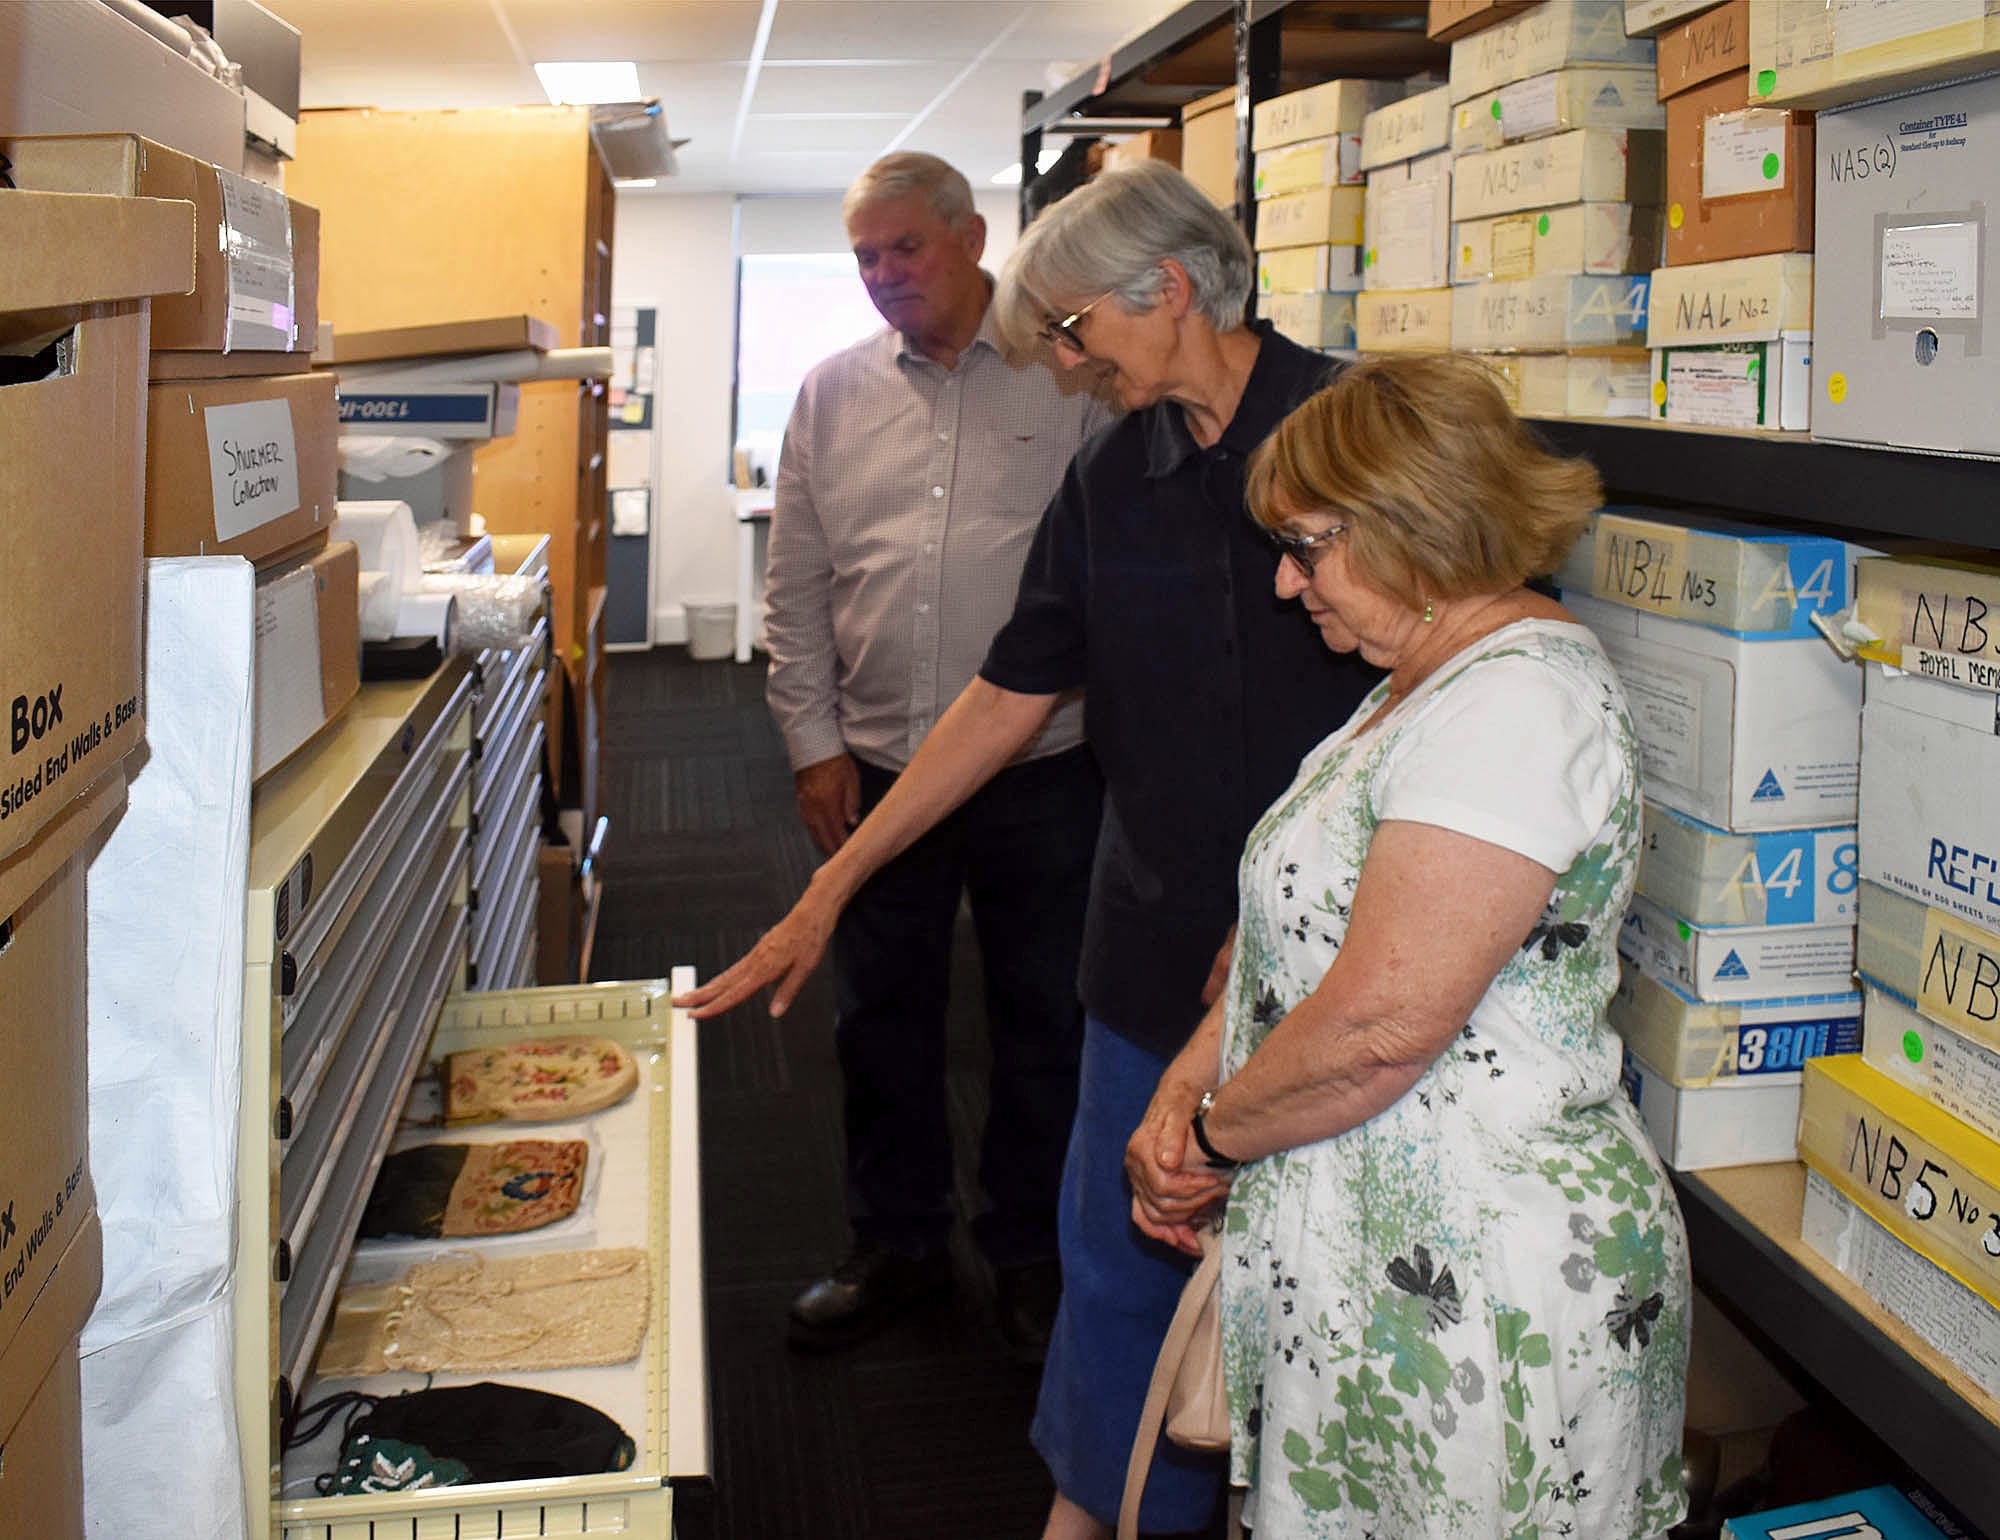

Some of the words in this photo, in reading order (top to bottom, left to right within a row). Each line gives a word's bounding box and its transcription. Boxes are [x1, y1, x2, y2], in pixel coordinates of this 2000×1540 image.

[1899, 120, 1933, 131] Container
[1573, 283, 1647, 326] A4
[1752, 559, 1833, 611] A4
[1912, 593, 2000, 654] NB
[1920, 651, 1960, 680] ROYAL
[11, 683, 63, 755] Box
[46, 744, 68, 786] End
[71, 721, 101, 764] Walls
[104, 712, 112, 738] &
[115, 696, 136, 729] Base
[1717, 848, 1803, 902] A4
[4, 1248, 24, 1299] End
[26, 1210, 54, 1261] Walls
[56, 1192, 64, 1217] &
